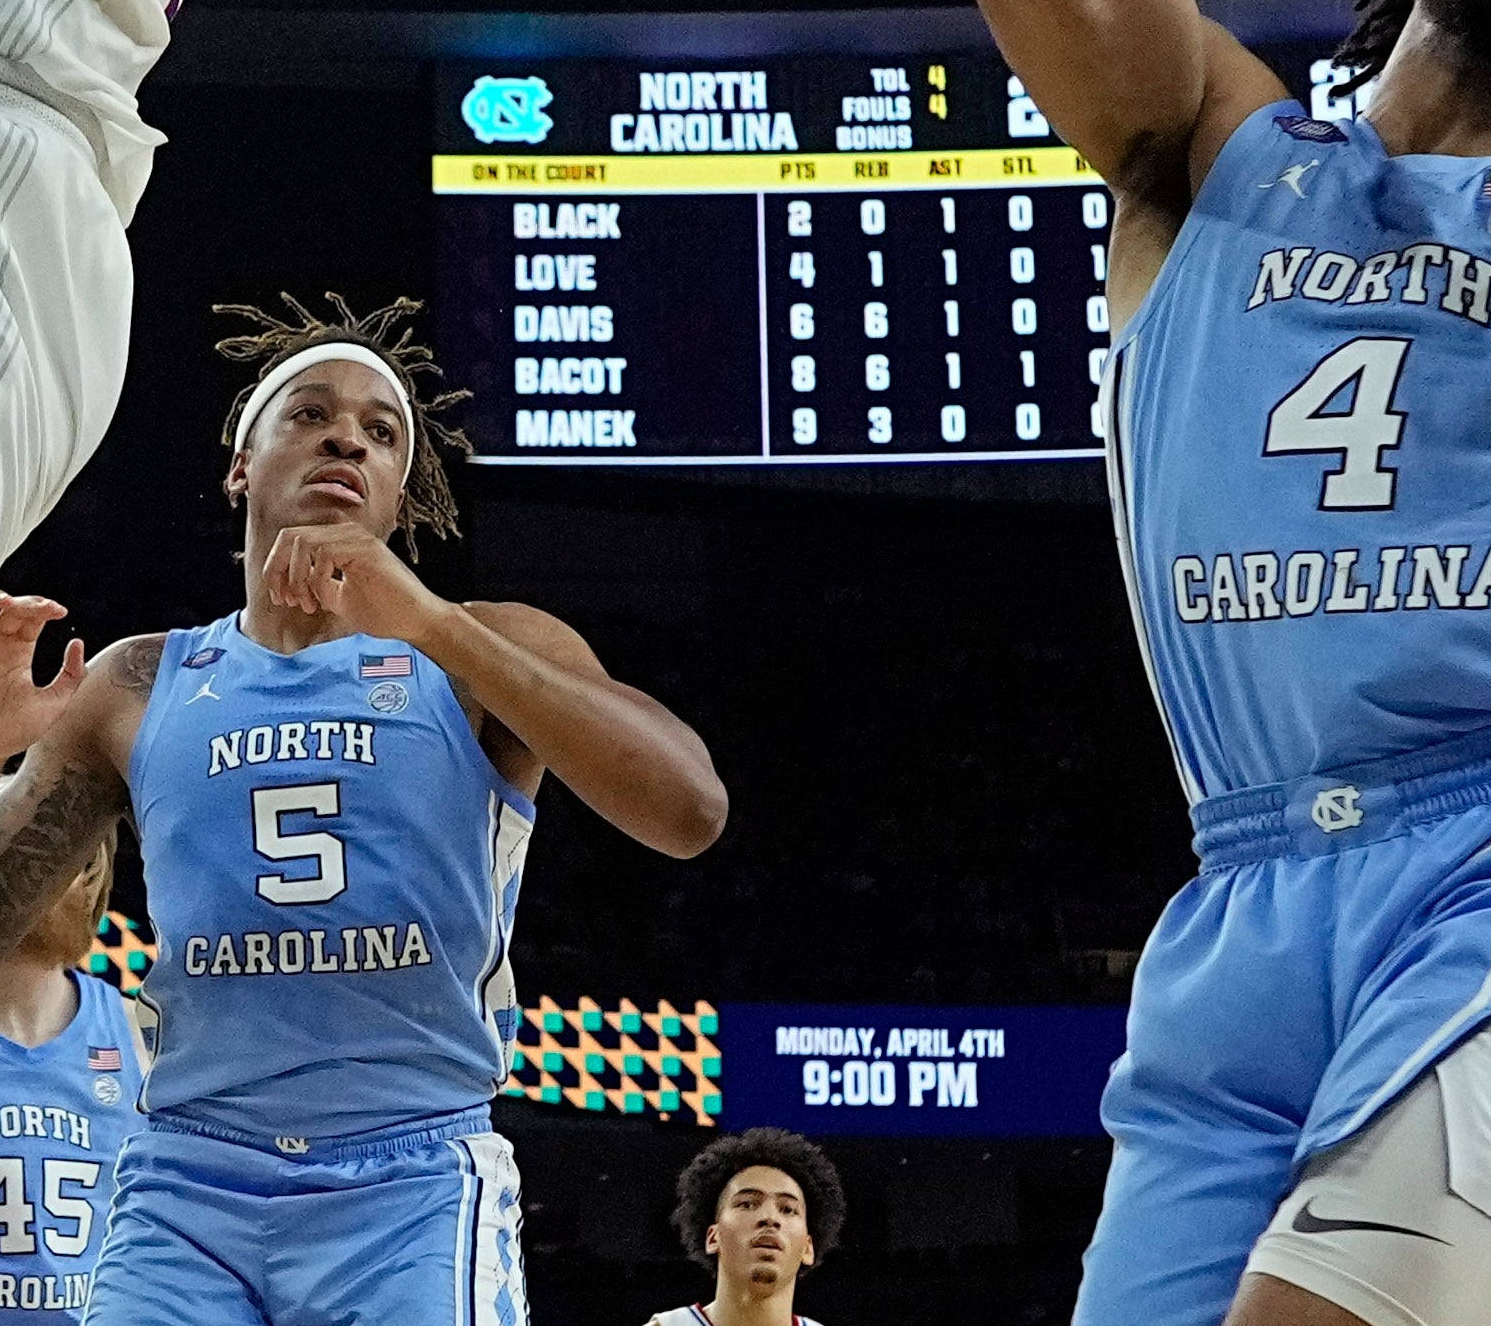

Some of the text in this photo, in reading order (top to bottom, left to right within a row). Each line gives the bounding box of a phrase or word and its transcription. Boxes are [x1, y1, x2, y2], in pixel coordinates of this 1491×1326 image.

[639, 70, 769, 111] NORTH
[869, 65, 948, 93] TOL 4
[841, 94, 949, 122] FOULS 4
[609, 111, 800, 153] CAROLINA
[835, 124, 913, 151] BONUS
[545, 163, 609, 182] COURT
[779, 161, 817, 181] PTS
[927, 159, 964, 177] AST
[1002, 158, 1037, 176] STL
[512, 192, 1107, 240] BLACK 2 0 1 0 0
[514, 254, 598, 291] LOVE
[788, 251, 817, 289] 4
[867, 250, 885, 287] 1
[941, 249, 959, 286] 1
[1009, 246, 1037, 284] 0
[514, 305, 614, 343] DAVIS
[789, 303, 816, 341] 6
[862, 302, 889, 340] 6
[943, 299, 960, 337] 1
[1011, 298, 1038, 335] 0
[514, 357, 628, 395] BACOT
[790, 354, 817, 392] 8
[865, 353, 890, 392] 6
[944, 351, 962, 389] 1
[1019, 350, 1037, 388] 1
[514, 409, 637, 448] MANEK
[791, 407, 818, 445] 9
[867, 406, 893, 444] 3
[940, 404, 967, 443] 0
[1014, 403, 1042, 441] 0
[1260, 335, 1415, 512] 4
[207, 718, 379, 779] NORTH
[250, 779, 350, 908] 5
[181, 922, 434, 980] CAROLINA
[774, 1026, 1006, 1059] MONDAY, APRIL 4TH
[802, 1059, 979, 1109] 9:00 PM
